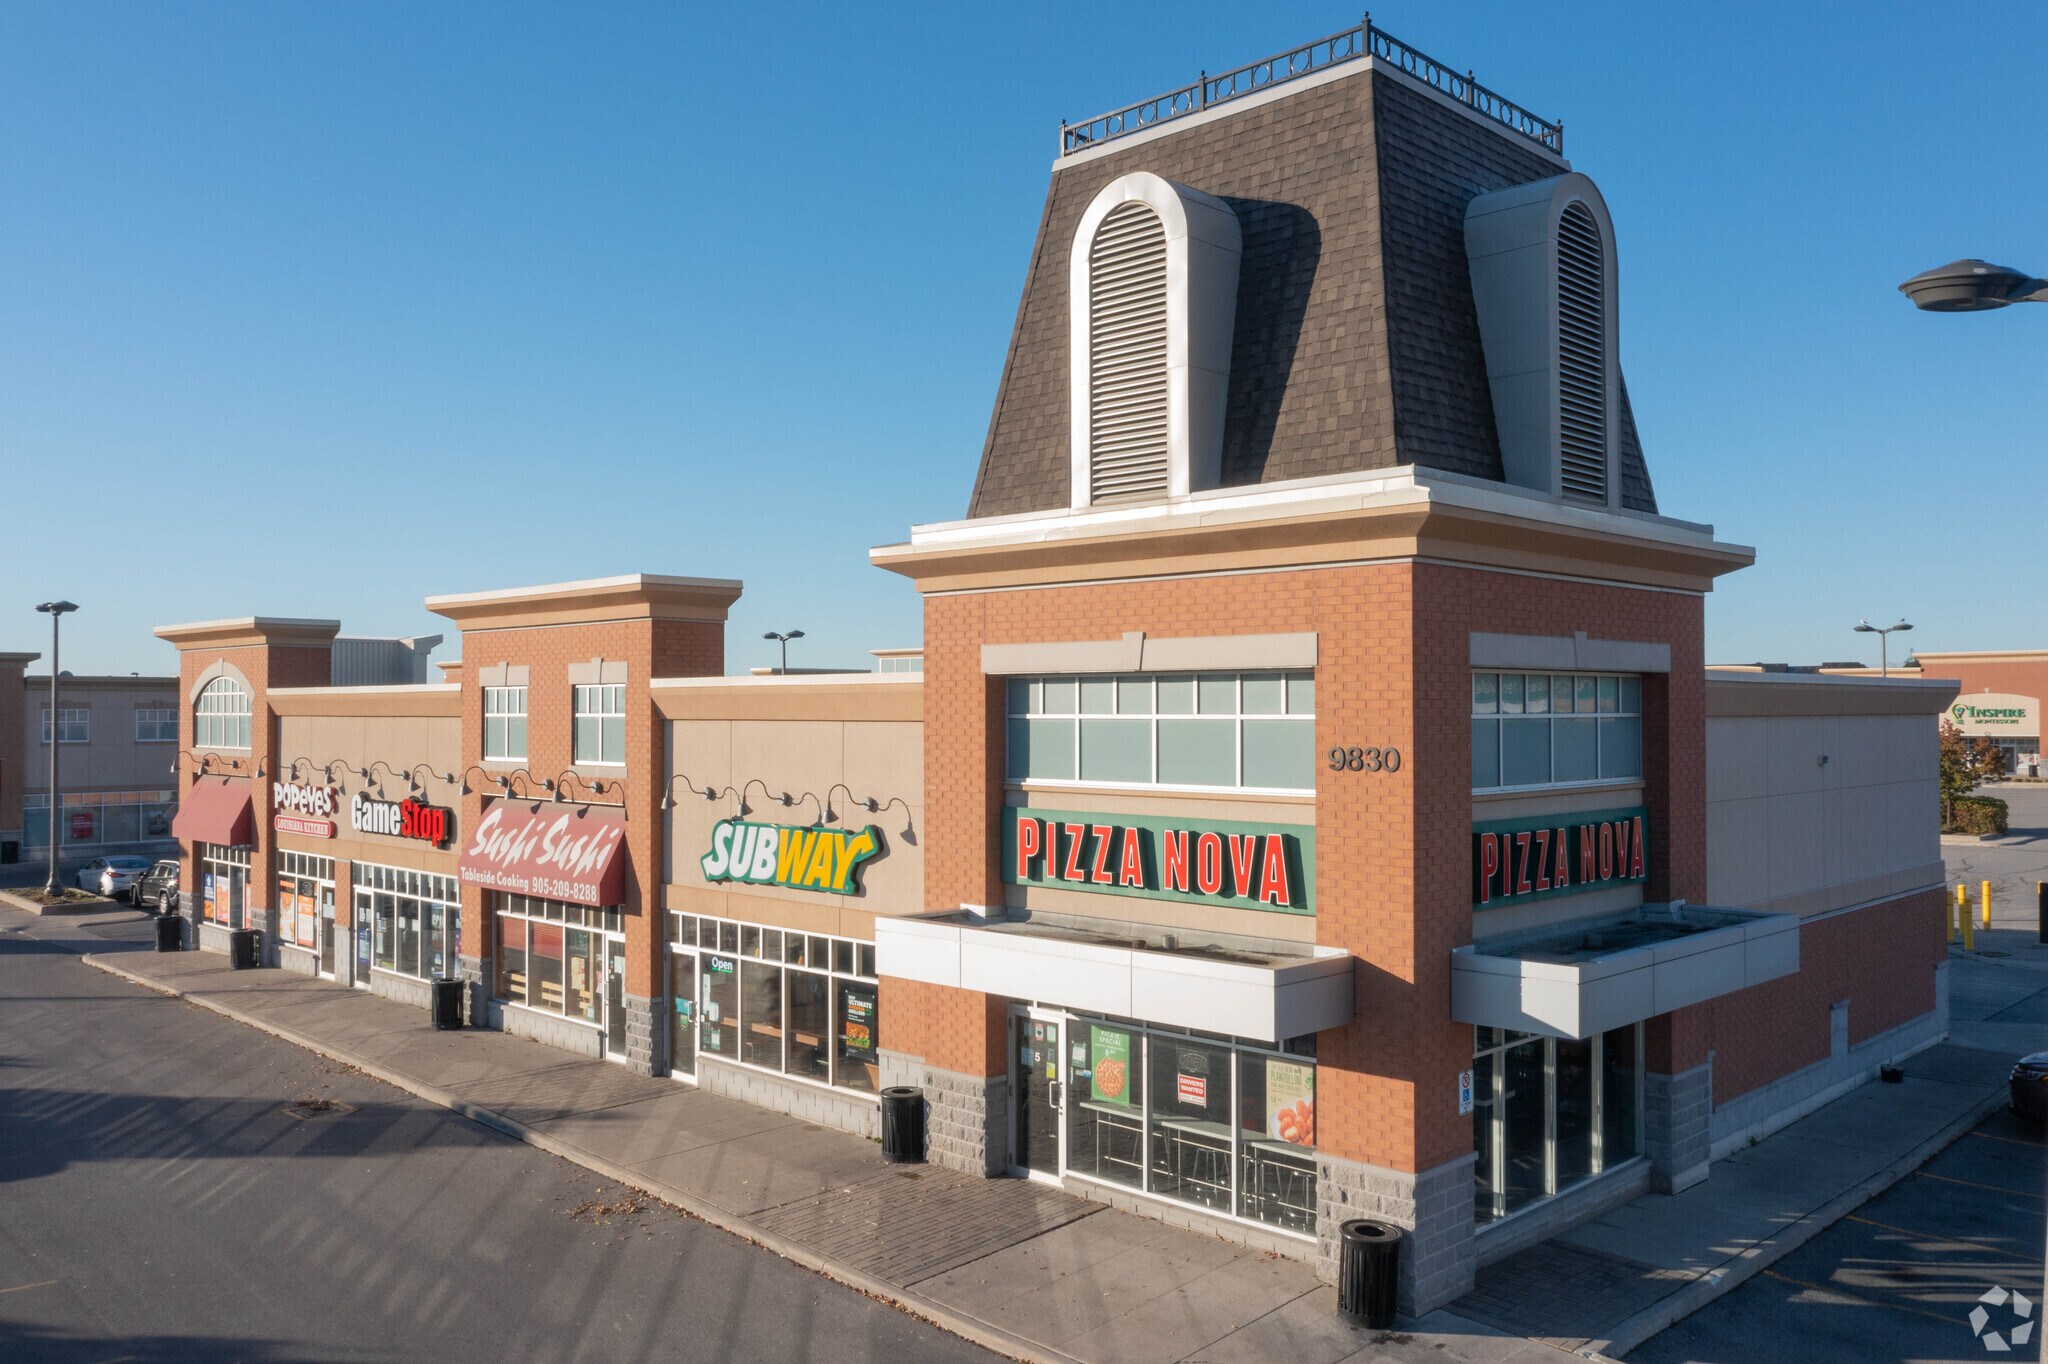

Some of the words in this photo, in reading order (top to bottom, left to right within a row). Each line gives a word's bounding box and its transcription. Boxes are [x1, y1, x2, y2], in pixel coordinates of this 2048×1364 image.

[1968, 706, 2026, 718] INSPIRE
[1327, 746, 1400, 773] 9830
[277, 818, 303, 832] LOUISIANA
[303, 821, 329, 836] KITCHEN
[352, 794, 444, 847] GameStop
[469, 807, 546, 869] Sushi
[536, 813, 619, 878] Sushi
[702, 823, 874, 890] SUBWAY
[1017, 817, 1144, 888] PIZZA
[1163, 829, 1290, 906] NOVA
[1481, 827, 1569, 904] PIZZA
[1580, 816, 1645, 884] NOVA
[460, 866, 495, 885] Tableside
[497, 872, 529, 892] Cooking
[532, 876, 597, 902] 905-209-8288
[711, 956, 733, 971] Open
[848, 1000, 872, 1009] ULTIMATE
[1099, 1036, 1121, 1047] SPECIAL
[1034, 1052, 1041, 1062] 5
[1180, 1077, 1204, 1087] DRIVERS
[1180, 1084, 1204, 1095] WANTED
